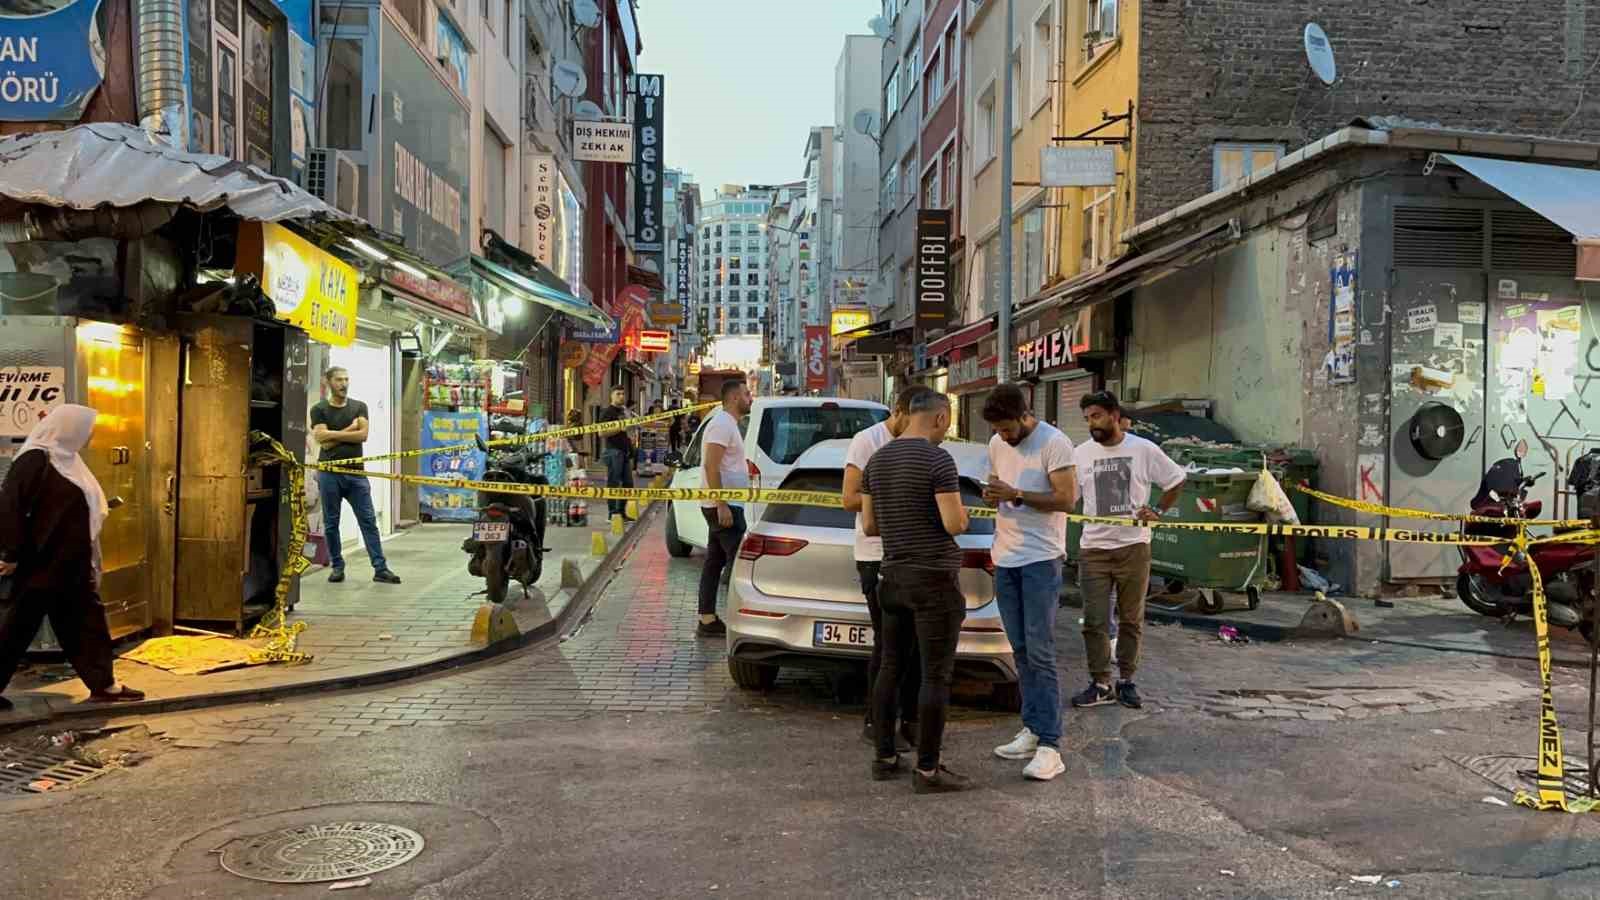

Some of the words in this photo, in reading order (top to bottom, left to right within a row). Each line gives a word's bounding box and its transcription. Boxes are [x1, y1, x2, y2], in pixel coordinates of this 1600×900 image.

[609, 143, 624, 152] AK
[641, 126, 657, 242] Bebito
[320, 262, 347, 306] KAYA
[1017, 325, 1073, 378] REFLEX
[824, 625, 841, 642] 34
[849, 627, 867, 644] GE
